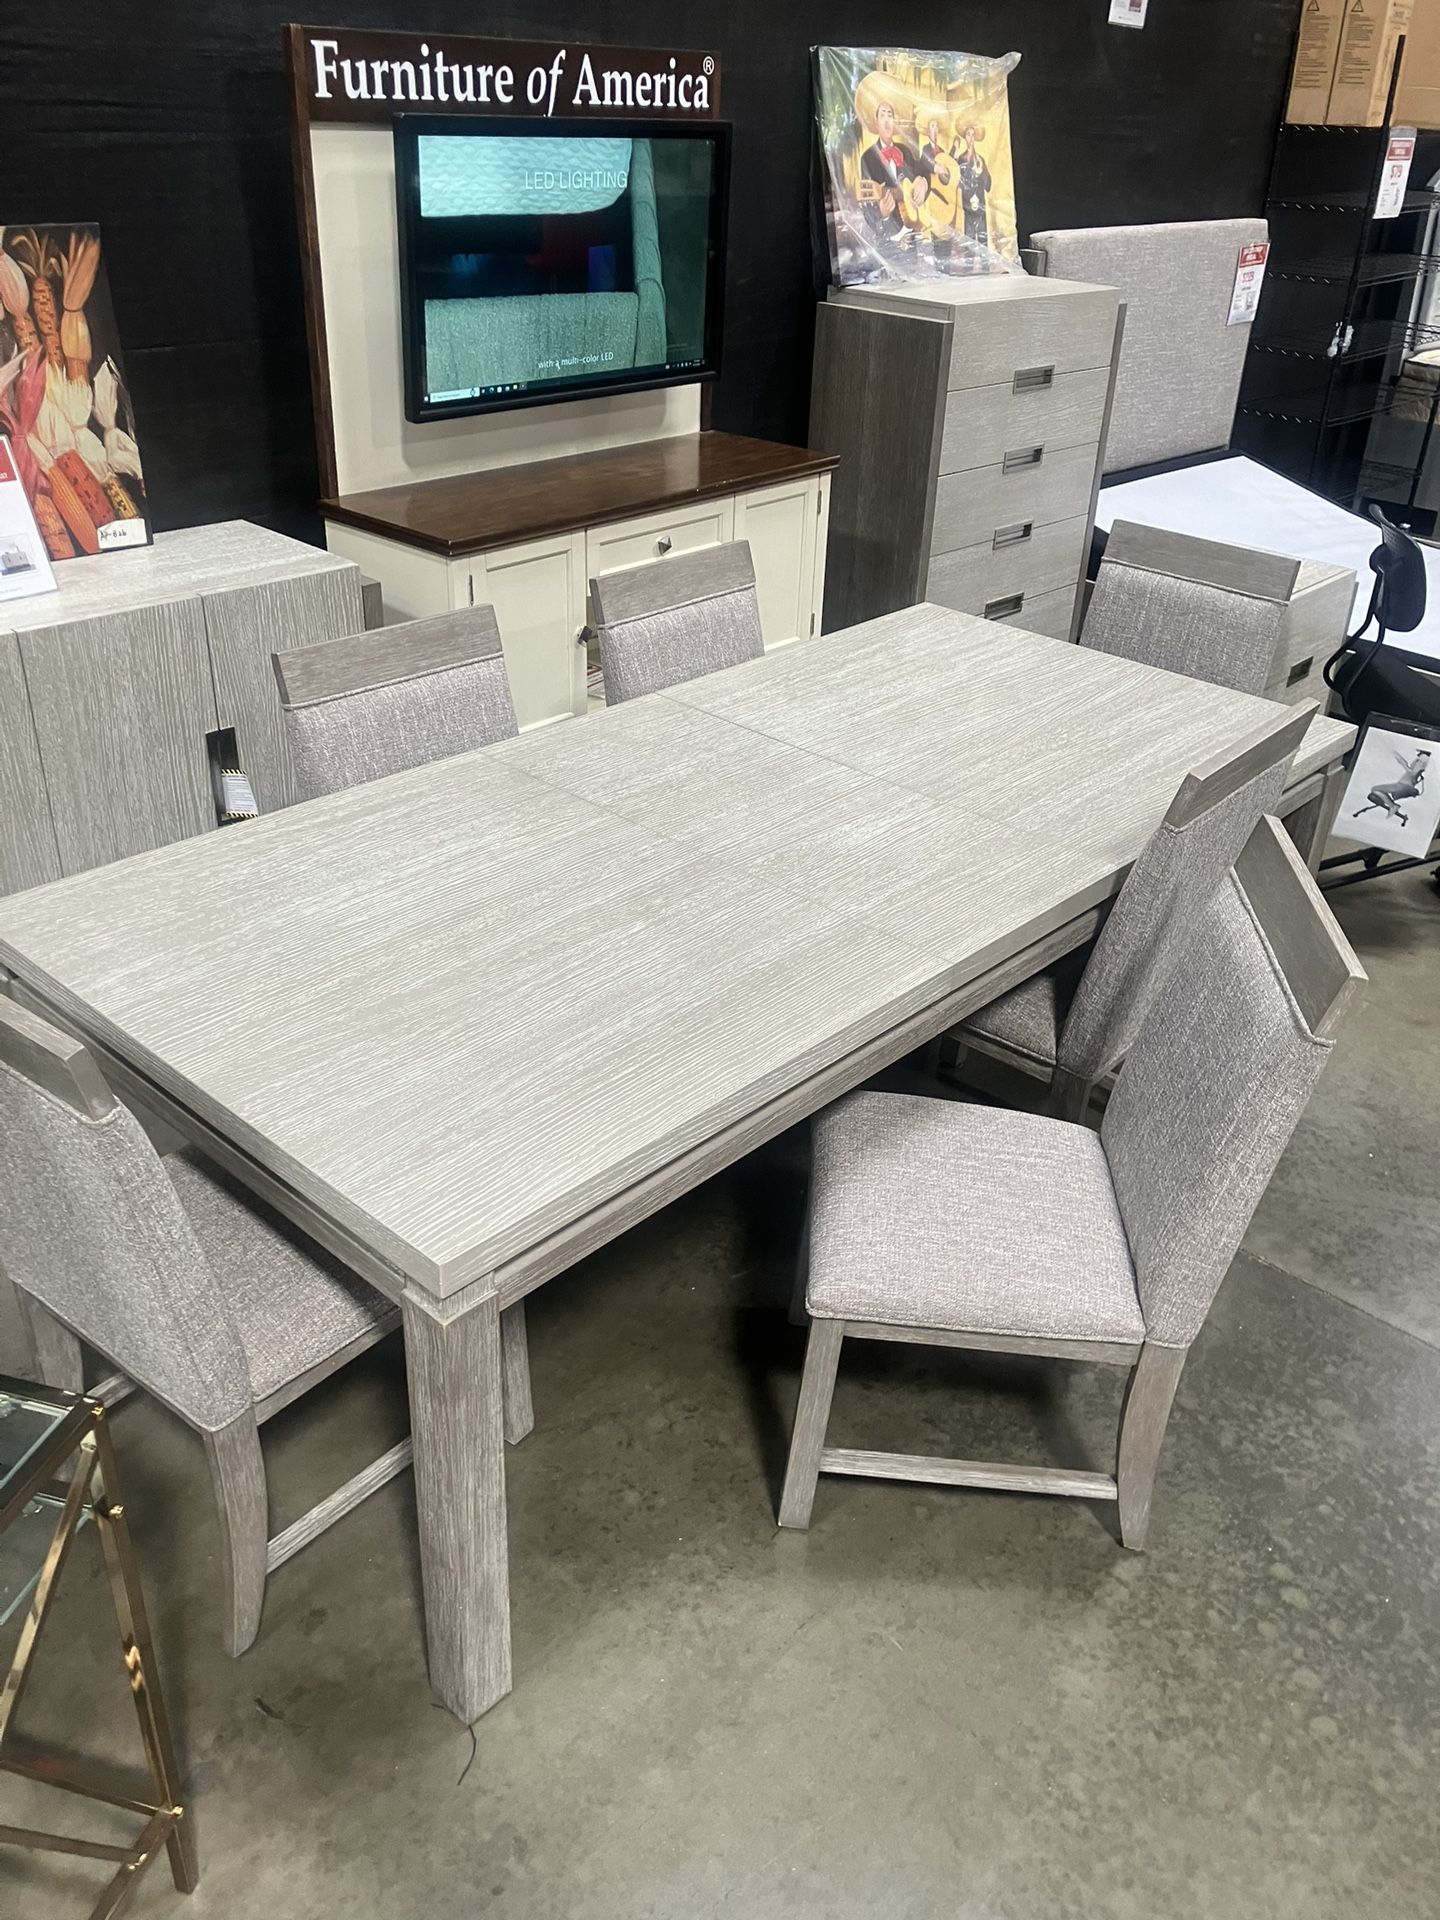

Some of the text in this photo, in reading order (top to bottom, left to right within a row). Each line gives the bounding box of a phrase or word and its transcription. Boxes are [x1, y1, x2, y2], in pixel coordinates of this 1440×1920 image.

[310, 39, 515, 103] Furniture
[526, 49, 567, 117] of
[525, 170, 628, 190] LED LIGHTING
[561, 354, 599, 366] multi-color
[600, 351, 614, 361] LED
